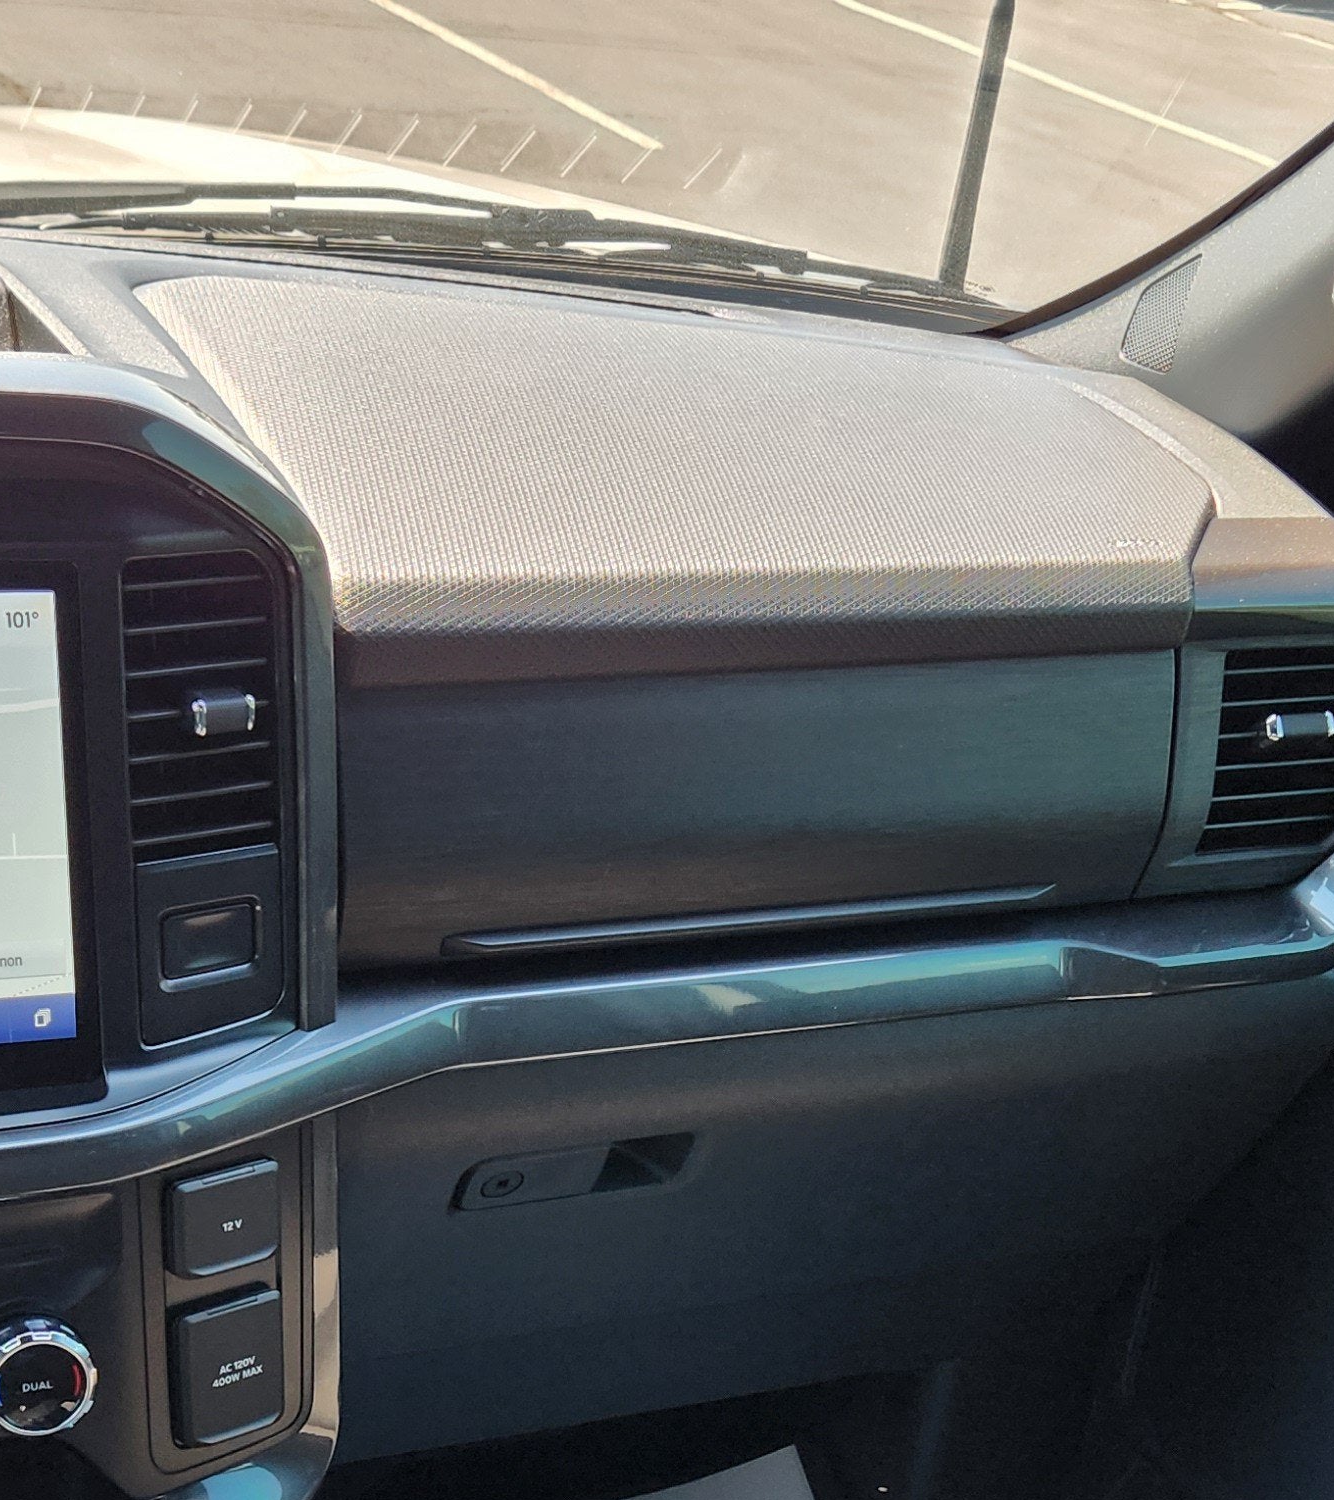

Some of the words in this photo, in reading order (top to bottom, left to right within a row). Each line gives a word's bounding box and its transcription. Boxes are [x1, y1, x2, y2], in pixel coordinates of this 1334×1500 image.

[222, 1220, 234, 1232] 12
[219, 1363, 233, 1376] AC
[233, 1355, 257, 1372] 120V
[212, 1371, 241, 1388] 400W
[242, 1364, 264, 1380] MAX
[22, 1379, 54, 1393] DUAL
